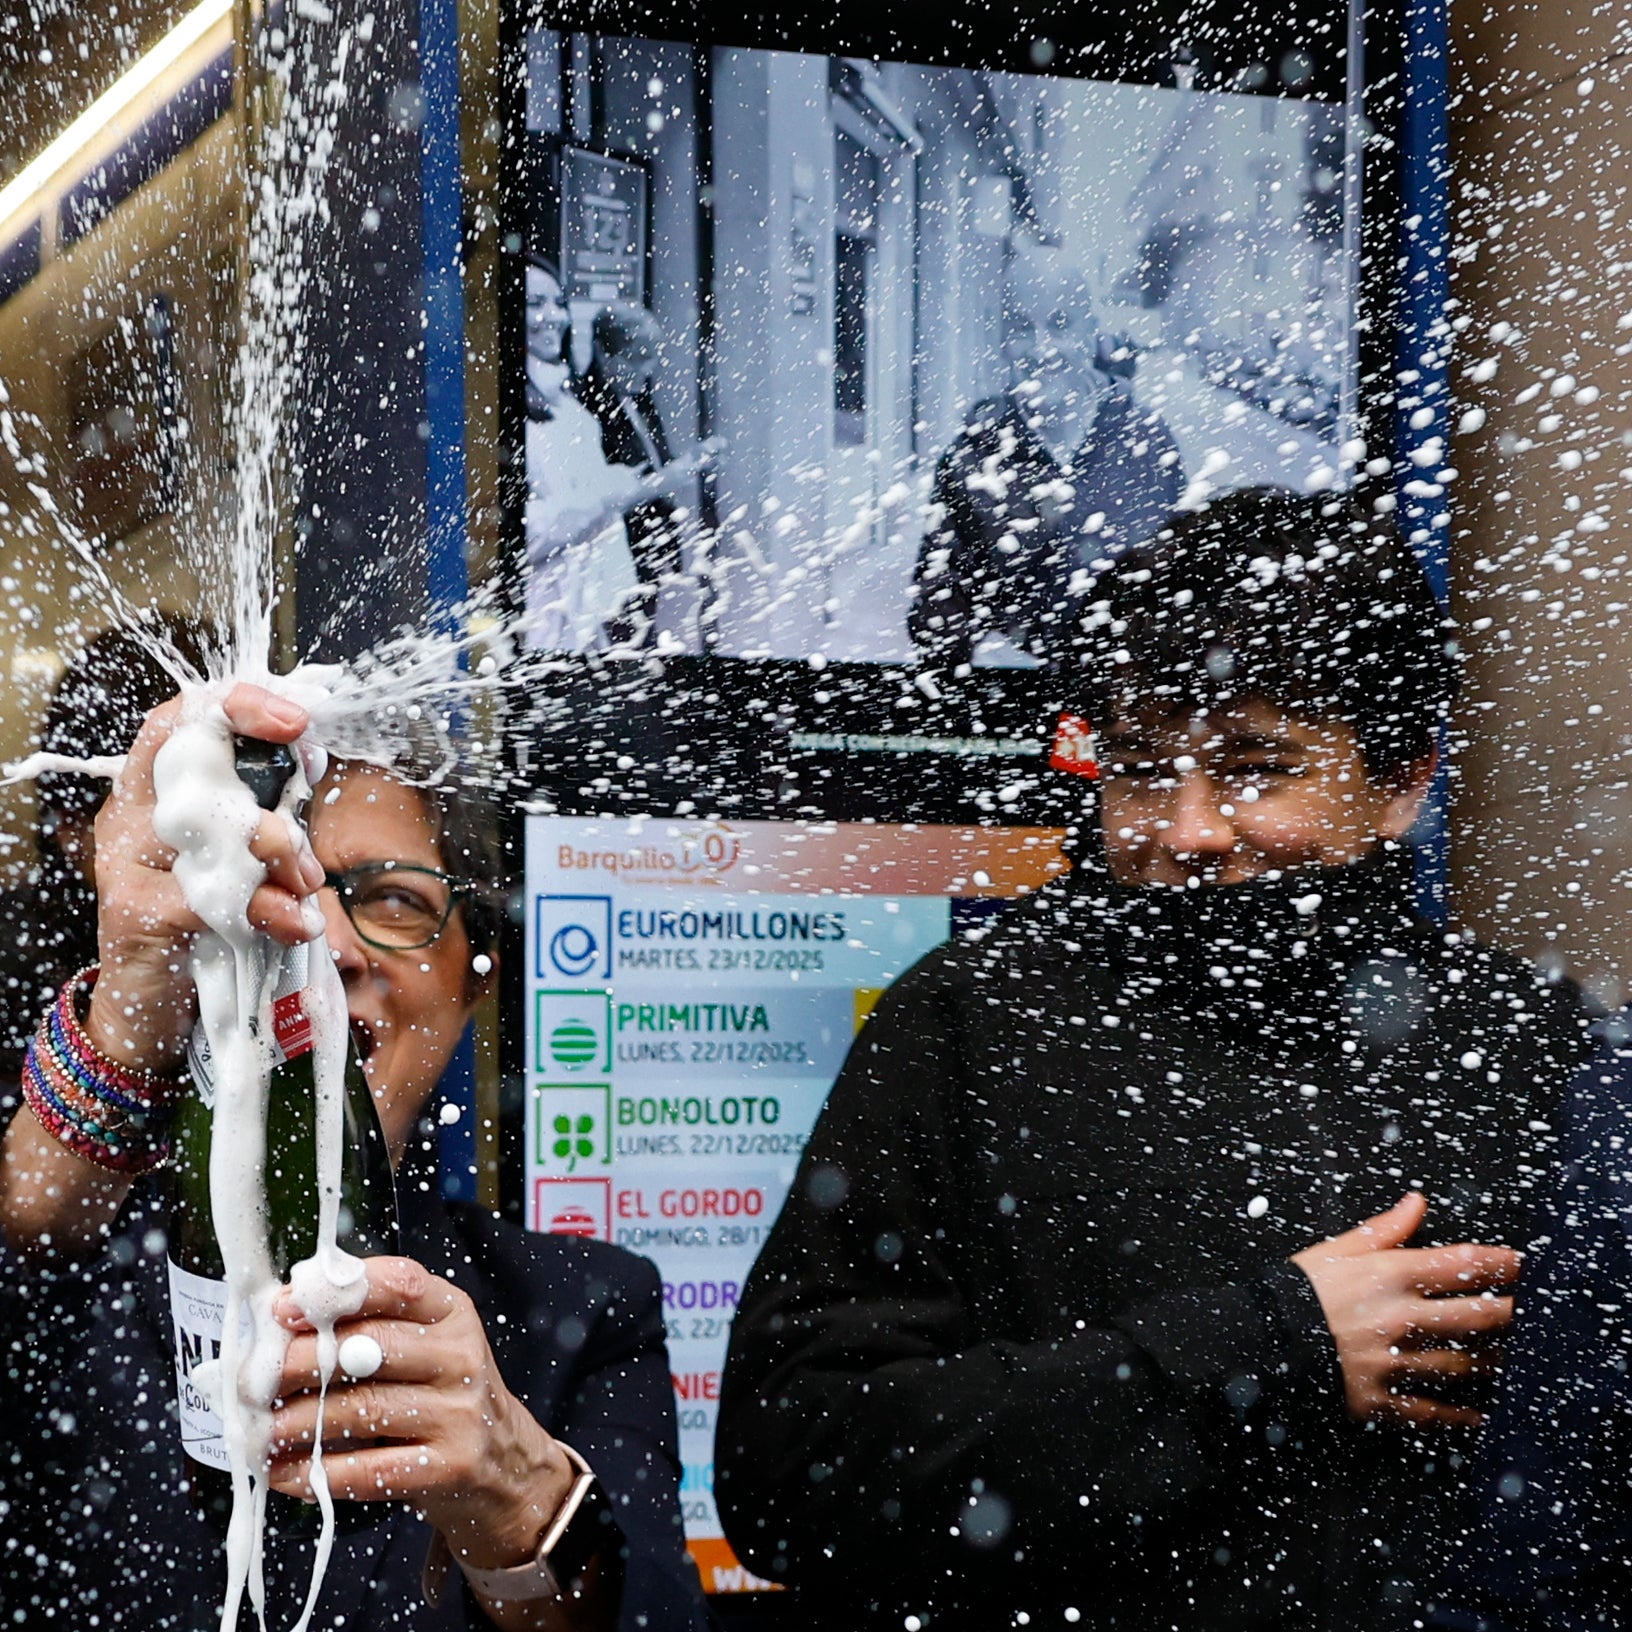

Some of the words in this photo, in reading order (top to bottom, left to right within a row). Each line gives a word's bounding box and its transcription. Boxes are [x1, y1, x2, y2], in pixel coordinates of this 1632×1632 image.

[558, 844, 676, 875] Barquillo
[618, 909, 848, 941] EUROMILLONES
[708, 949, 825, 971] 23/12/2025
[617, 1003, 771, 1033] PRIMITIVA
[690, 1041, 808, 1063] 22/12/2025
[617, 1097, 781, 1125] BONOLOTO
[617, 1190, 650, 1219] EL
[659, 1188, 763, 1218] GORDO
[718, 1225, 771, 1246] 28/1
[199, 1442, 228, 1461] BRUT
